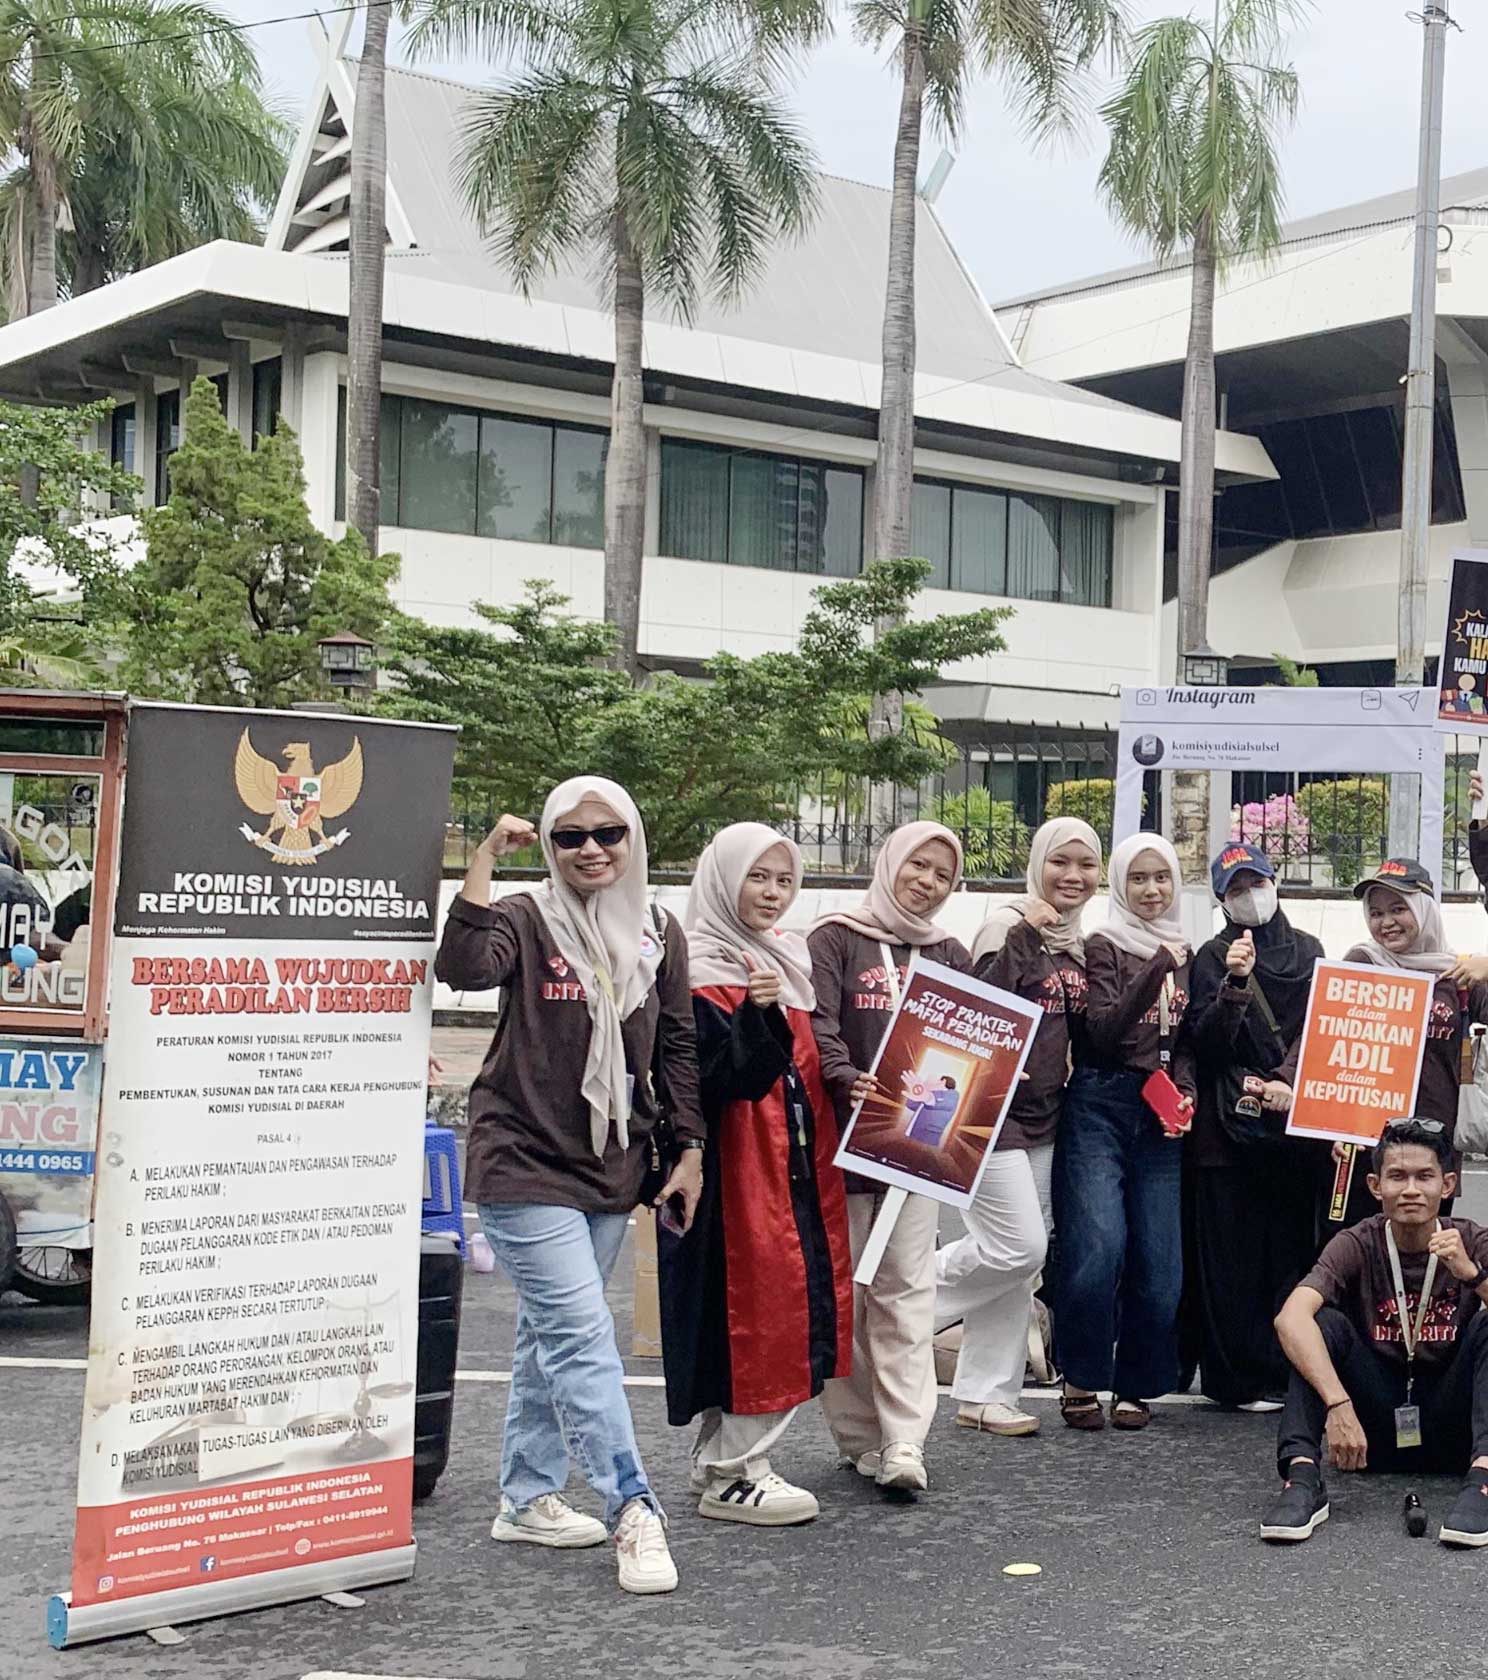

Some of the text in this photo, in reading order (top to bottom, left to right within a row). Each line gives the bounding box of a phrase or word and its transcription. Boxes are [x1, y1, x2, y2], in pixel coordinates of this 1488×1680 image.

[1453, 657, 1487, 675] KAMU
[1165, 688, 1256, 709] Instagram
[1172, 740, 1280, 754] komisiyudisialsulsel
[174, 873, 402, 899] KOMISI YUDISIAL
[138, 893, 428, 919] REPUBLIK INDONESIA
[132, 958, 427, 984] BERSAMA WUJUDKAN
[150, 987, 412, 1014] PERADILAN BERSIH
[1326, 976, 1416, 1012] BERSIH
[903, 998, 1023, 1052] MAFIA PERADILAN
[919, 991, 1018, 1035] STOP PRAKTEK
[1346, 1005, 1387, 1022] dalam
[156, 1032, 401, 1047] PERATURAN KOMISI YUDISIAL REPUBLIK INDONESIA
[922, 1026, 967, 1051] SEKARANG
[1318, 1015, 1415, 1047] TINDAKAN
[228, 1050, 332, 1062] NOMOR 1 TAHUN 2017
[1327, 1040, 1394, 1074] ADIL
[259, 1068, 302, 1078] TENTANG
[1336, 1070, 1377, 1086] dalam
[202, 1085, 250, 1097] SUSUNAN
[254, 1085, 274, 1096] DAN
[278, 1084, 299, 1095] TATA
[302, 1083, 326, 1094] CARA
[330, 1082, 360, 1094] KERJA
[1303, 1080, 1406, 1112] KEPUTUSAN
[208, 1100, 344, 1114] KOMISI YUDISIAL DI DAERAH
[257, 1133, 285, 1144] PASAL
[38, 1154, 83, 1171] 0965
[130, 1154, 396, 1182] A. MELAKUKAN PEMANTAUAN DAN PENGAWASAN TERHADAP
[145, 1184, 220, 1200] PERILAKU HAKIM
[126, 1204, 405, 1237] B. MENERIMA LAPORAN DARI MASYARAKAT BERKAITAN DENGAN
[140, 1224, 392, 1255] DUGAAN PELANGGARAN KODE ETIK DAN ATAU PEDOMAN
[139, 1257, 215, 1275] PERILAKU HAKIM
[121, 1274, 377, 1311] C. MELAKUKAN VERIFIKASI TERHADAP LAPORAN DUGAAN
[136, 1298, 324, 1329] PELANGGARAN KEPPH SECARA TERTUTUP
[132, 1324, 383, 1364] MENGAMBIL LANGKAH HUKUM DAN ATAU LANGKAH LAIN
[133, 1365, 180, 1384] TERHADAP
[182, 1361, 216, 1378] ORANG
[287, 1348, 335, 1366] KELOMPOK
[372, 1342, 393, 1357] ATAU
[130, 1473, 370, 1519] KOMISI YUDISIAL REPUBLIK INDONESIA
[115, 1485, 382, 1537] PENGHUBUNG WILAYAH SULAWESI SELATAN
